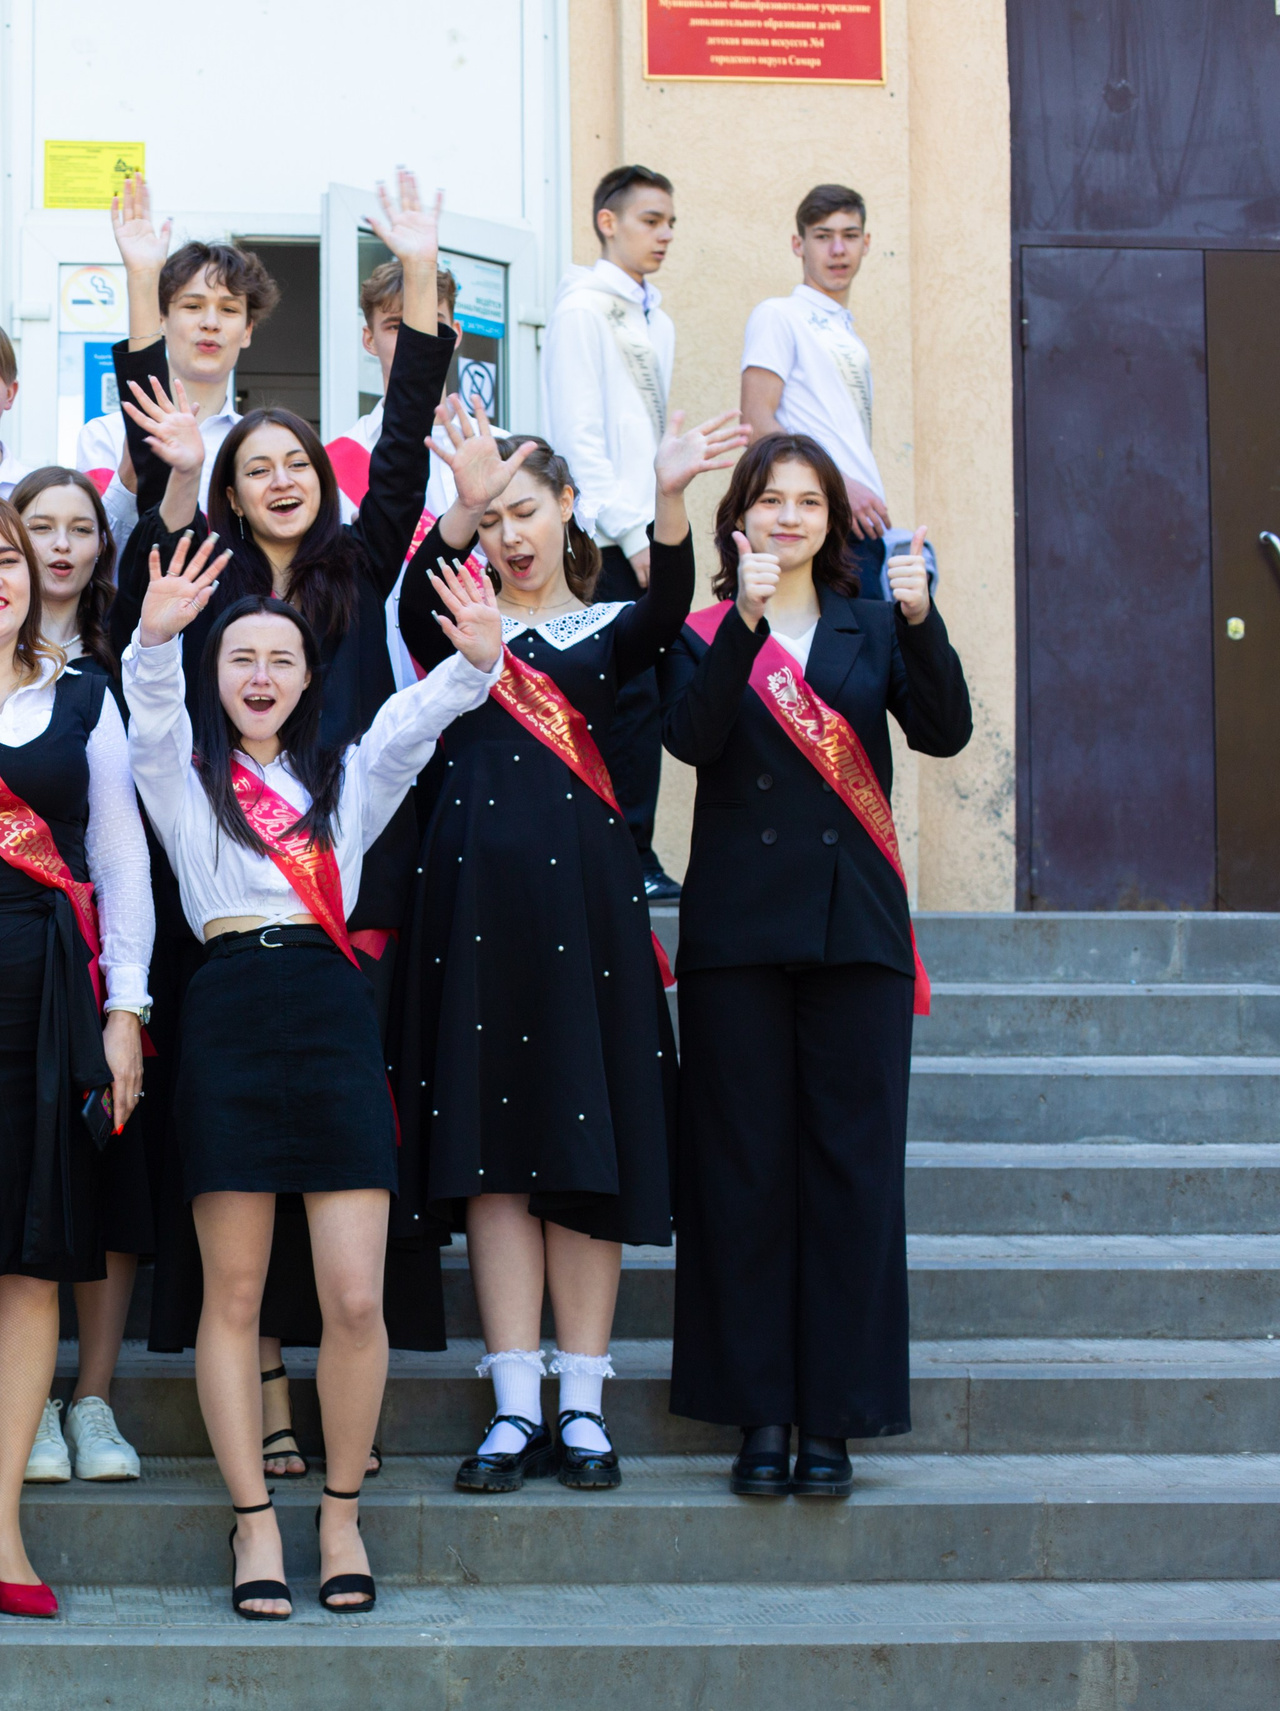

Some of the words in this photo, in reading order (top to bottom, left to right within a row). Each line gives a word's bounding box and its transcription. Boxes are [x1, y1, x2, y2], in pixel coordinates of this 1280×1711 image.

[689, 18, 762, 28] дополнительного
[763, 18, 816, 31] образования
[817, 20, 841, 31] детей
[706, 36, 740, 46] детская
[741, 37, 769, 47] школа
[710, 54, 757, 66] городского
[758, 56, 788, 68] округа
[788, 54, 821, 68] Самара
[793, 706, 896, 837] Выпускник
